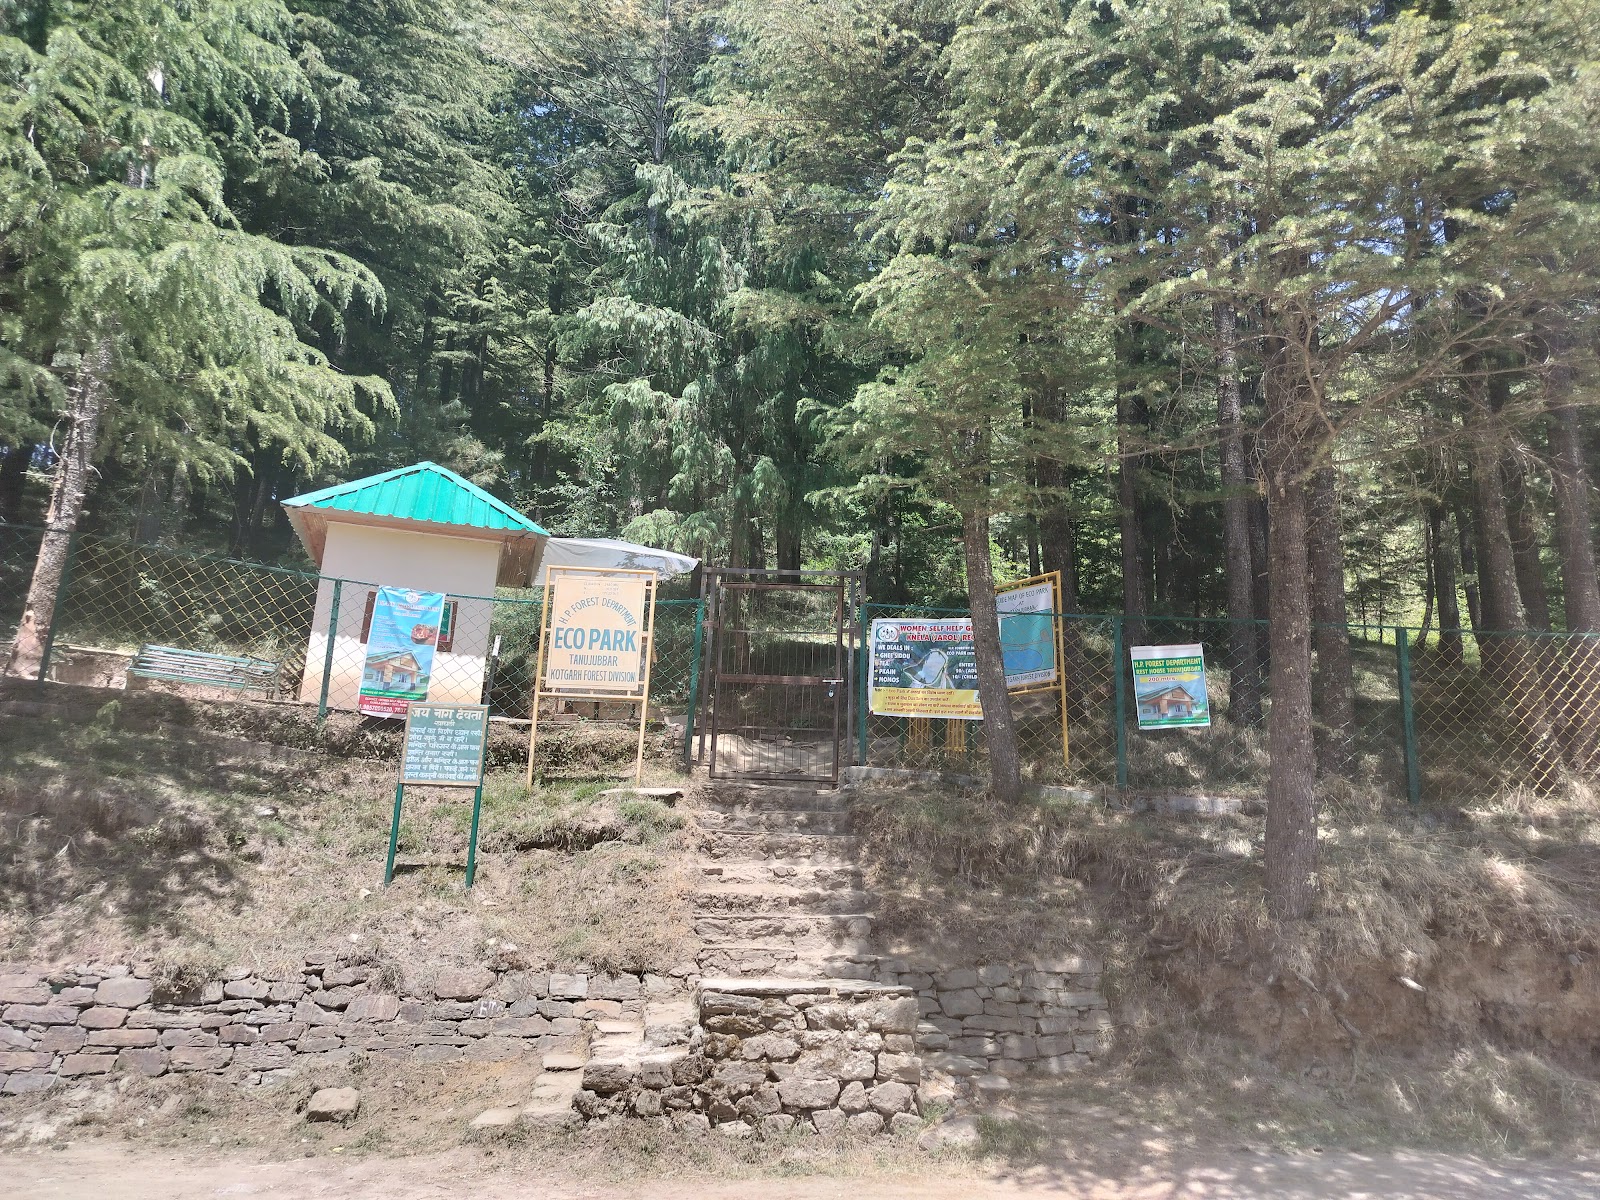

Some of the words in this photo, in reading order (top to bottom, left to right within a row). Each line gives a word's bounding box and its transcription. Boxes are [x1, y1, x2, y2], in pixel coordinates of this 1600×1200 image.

[570, 597, 600, 613] FOREST
[601, 597, 637, 627] DEPARTMENT
[554, 626, 586, 650] ECO
[588, 628, 637, 652] PARK
[569, 654, 618, 666] TANUJUBBAR
[1166, 658, 1201, 666] DEPARTMENT
[550, 669, 582, 681] KOTGARH
[584, 670, 607, 682] FOREST
[608, 671, 636, 682] DIVISION
[412, 707, 431, 718] जय
[434, 708, 454, 719] नाग
[456, 707, 483, 720] देवता
